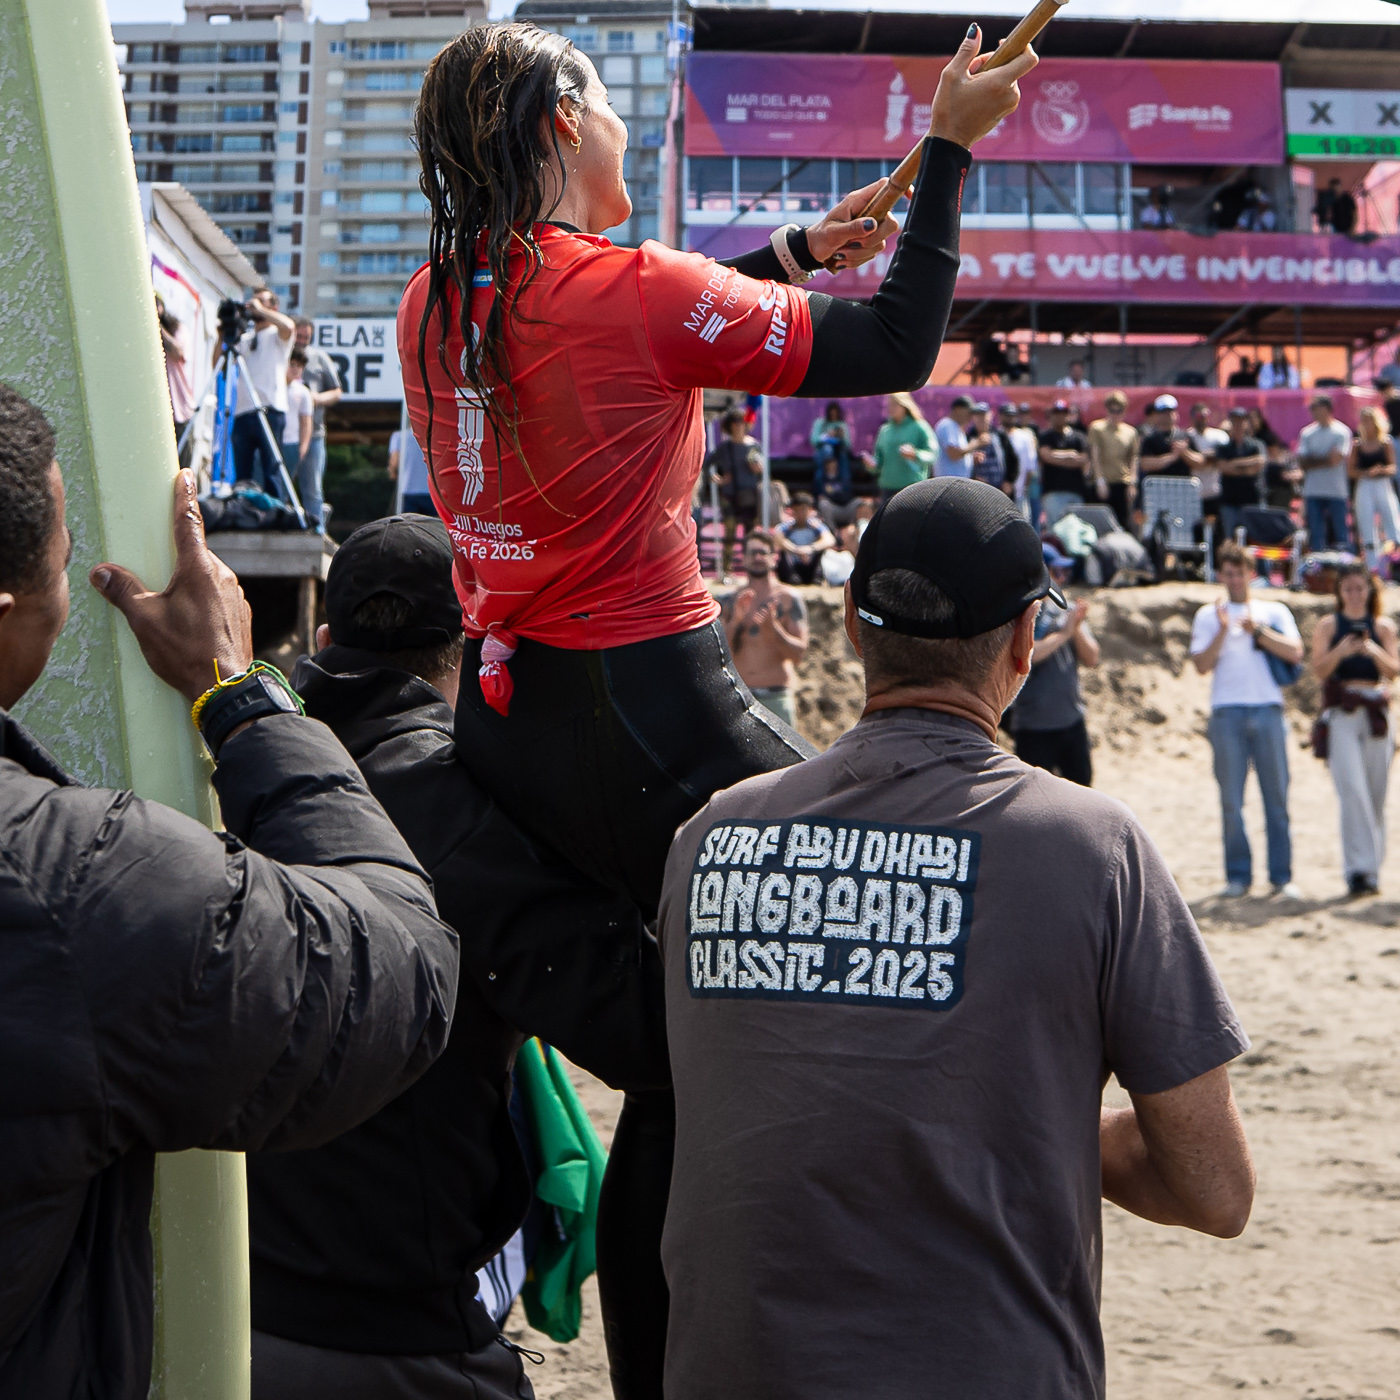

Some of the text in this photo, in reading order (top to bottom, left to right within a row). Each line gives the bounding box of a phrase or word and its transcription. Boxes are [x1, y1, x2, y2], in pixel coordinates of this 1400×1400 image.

[727, 93, 831, 108] MAR DEL PLATA
[989, 252, 1036, 280] TE
[1046, 252, 1187, 281] VUELVE
[683, 289, 718, 332] MAR
[722, 281, 743, 309] TODO
[764, 306, 788, 356] RIP
[472, 517, 523, 540] Juegos
[470, 543, 488, 560] Fe
[490, 543, 535, 560] 2026
[699, 823, 972, 882] SURF ABU DHABI
[689, 870, 964, 946] LONGBOARD
[844, 947, 956, 1001] 2025
